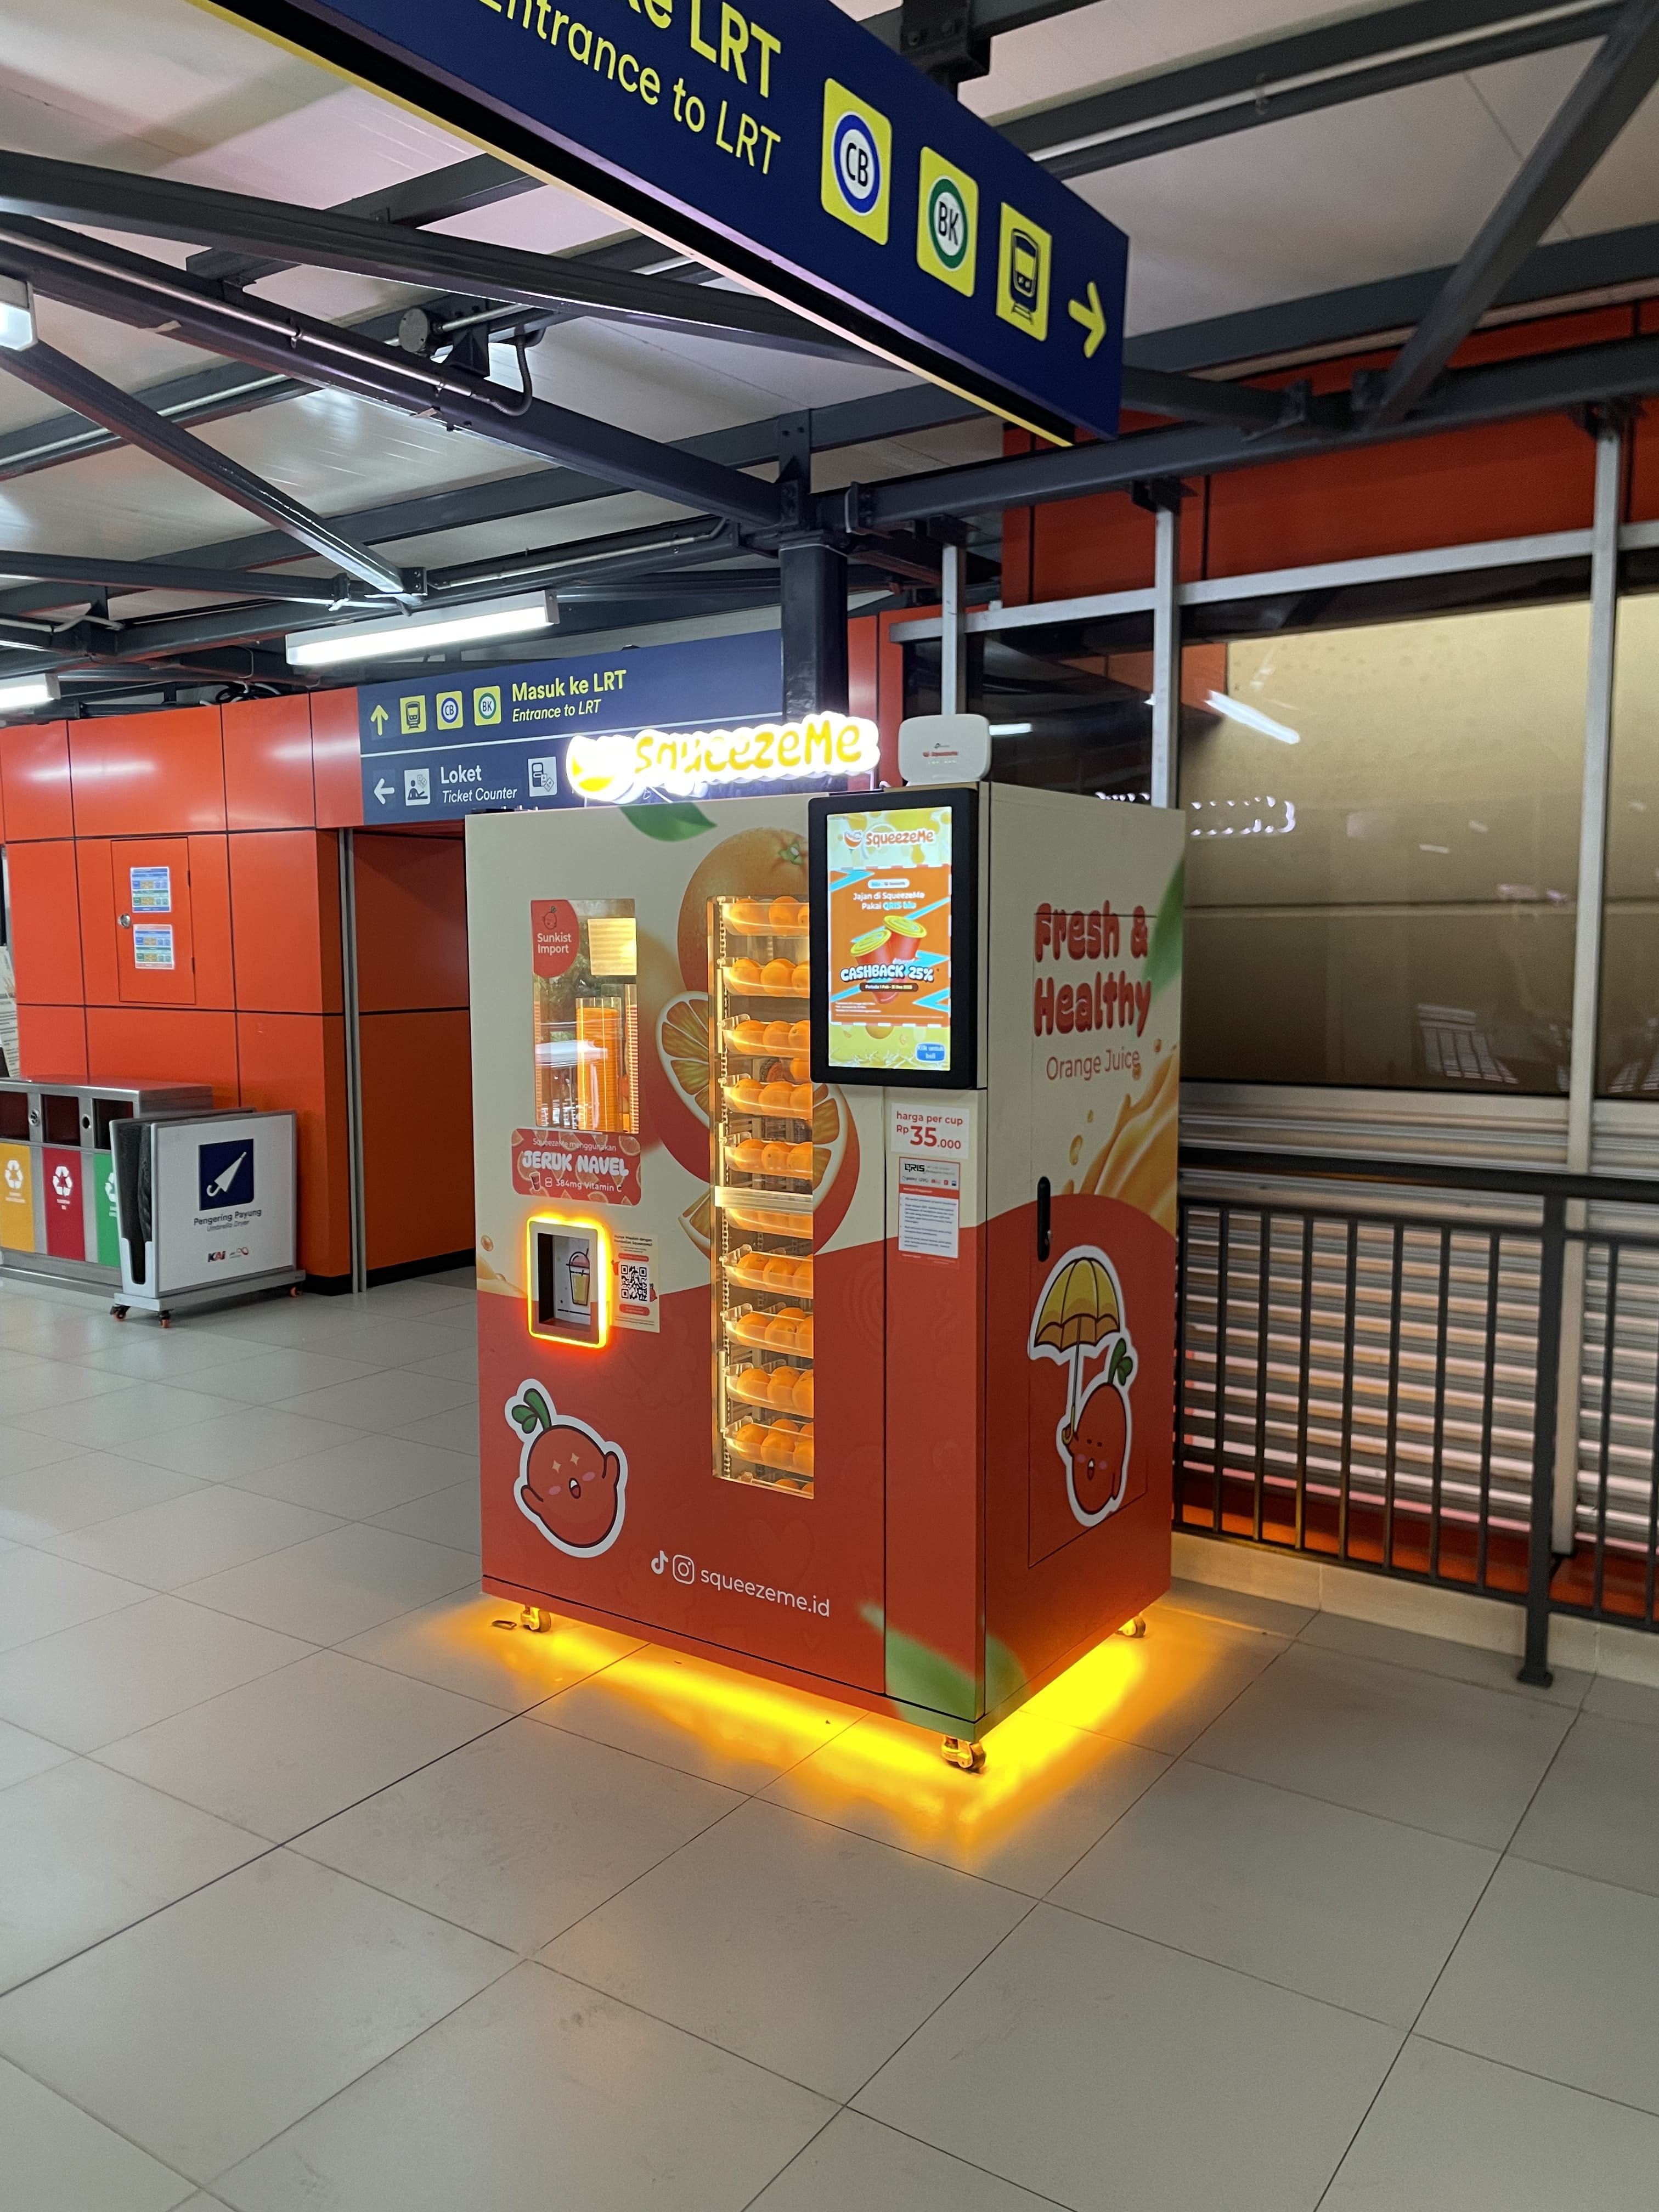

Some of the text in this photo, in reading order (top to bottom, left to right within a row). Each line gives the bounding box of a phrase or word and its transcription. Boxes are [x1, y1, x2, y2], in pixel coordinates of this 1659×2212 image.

[690, 0, 781, 98] LRT
[479, 0, 781, 174] ntrance to LRT
[846, 142, 868, 187] CB
[939, 201, 959, 246] BK
[512, 669, 627, 702] Masuk ke LRT
[444, 705, 454, 716] CB
[482, 701, 492, 712] BK
[512, 699, 602, 723] Entrance to LRT
[440, 764, 483, 785] Loket
[442, 787, 517, 804] Ticket Counter
[537, 932, 572, 943] Sunkist
[1035, 899, 1148, 962] Fresh &
[537, 943, 569, 955] Import
[840, 964, 934, 982] CASHBACK 25%
[1034, 970, 1151, 1037] Healthy
[1046, 1046, 1140, 1081] Orange Juice
[896, 1111, 963, 1127] harga per cup
[533, 1138, 616, 1152] SqueezeMe menggunakan
[522, 1150, 629, 1176] JERUK NAVEL
[904, 1163, 926, 1172] QRIS
[585, 1181, 614, 1192] Vitamin
[194, 1209, 262, 1226] Pengering Payung
[700, 1569, 830, 1617] squeezeme.id
